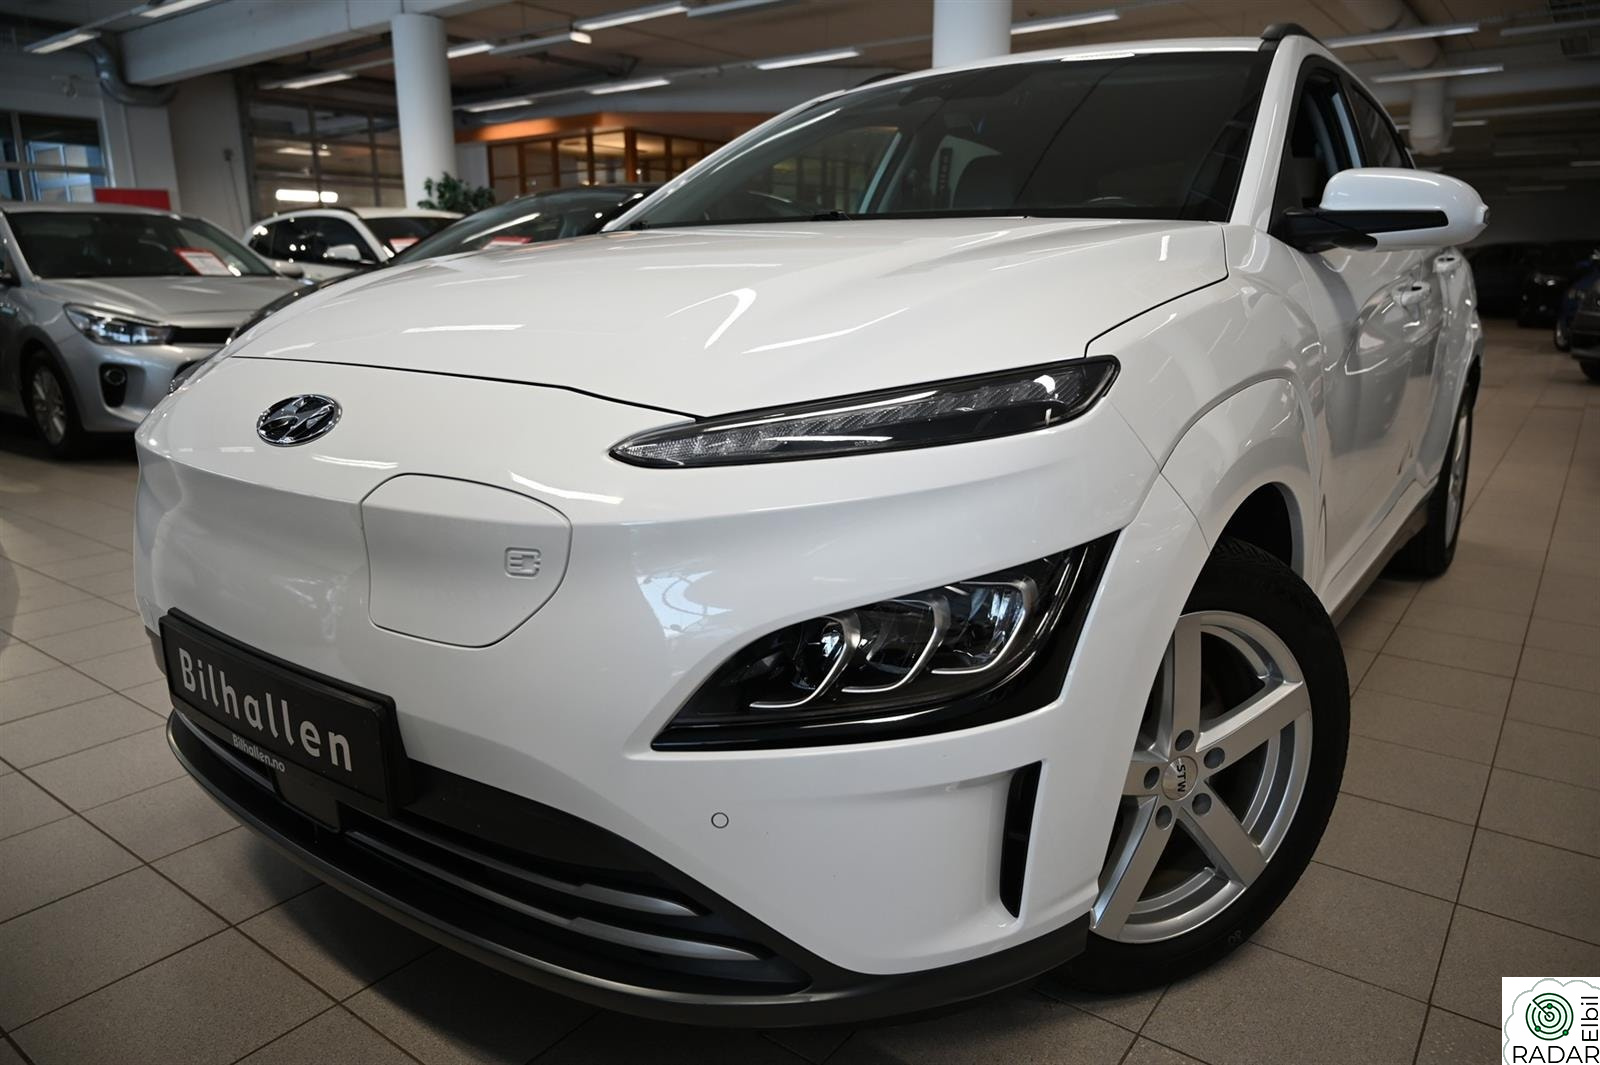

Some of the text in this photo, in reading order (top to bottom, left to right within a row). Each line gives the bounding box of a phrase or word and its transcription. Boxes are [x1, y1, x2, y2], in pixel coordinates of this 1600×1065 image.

[179, 647, 353, 773] Bilhallen
[232, 734, 286, 773] Bilhallen.no
[1177, 764, 1187, 792] STW
